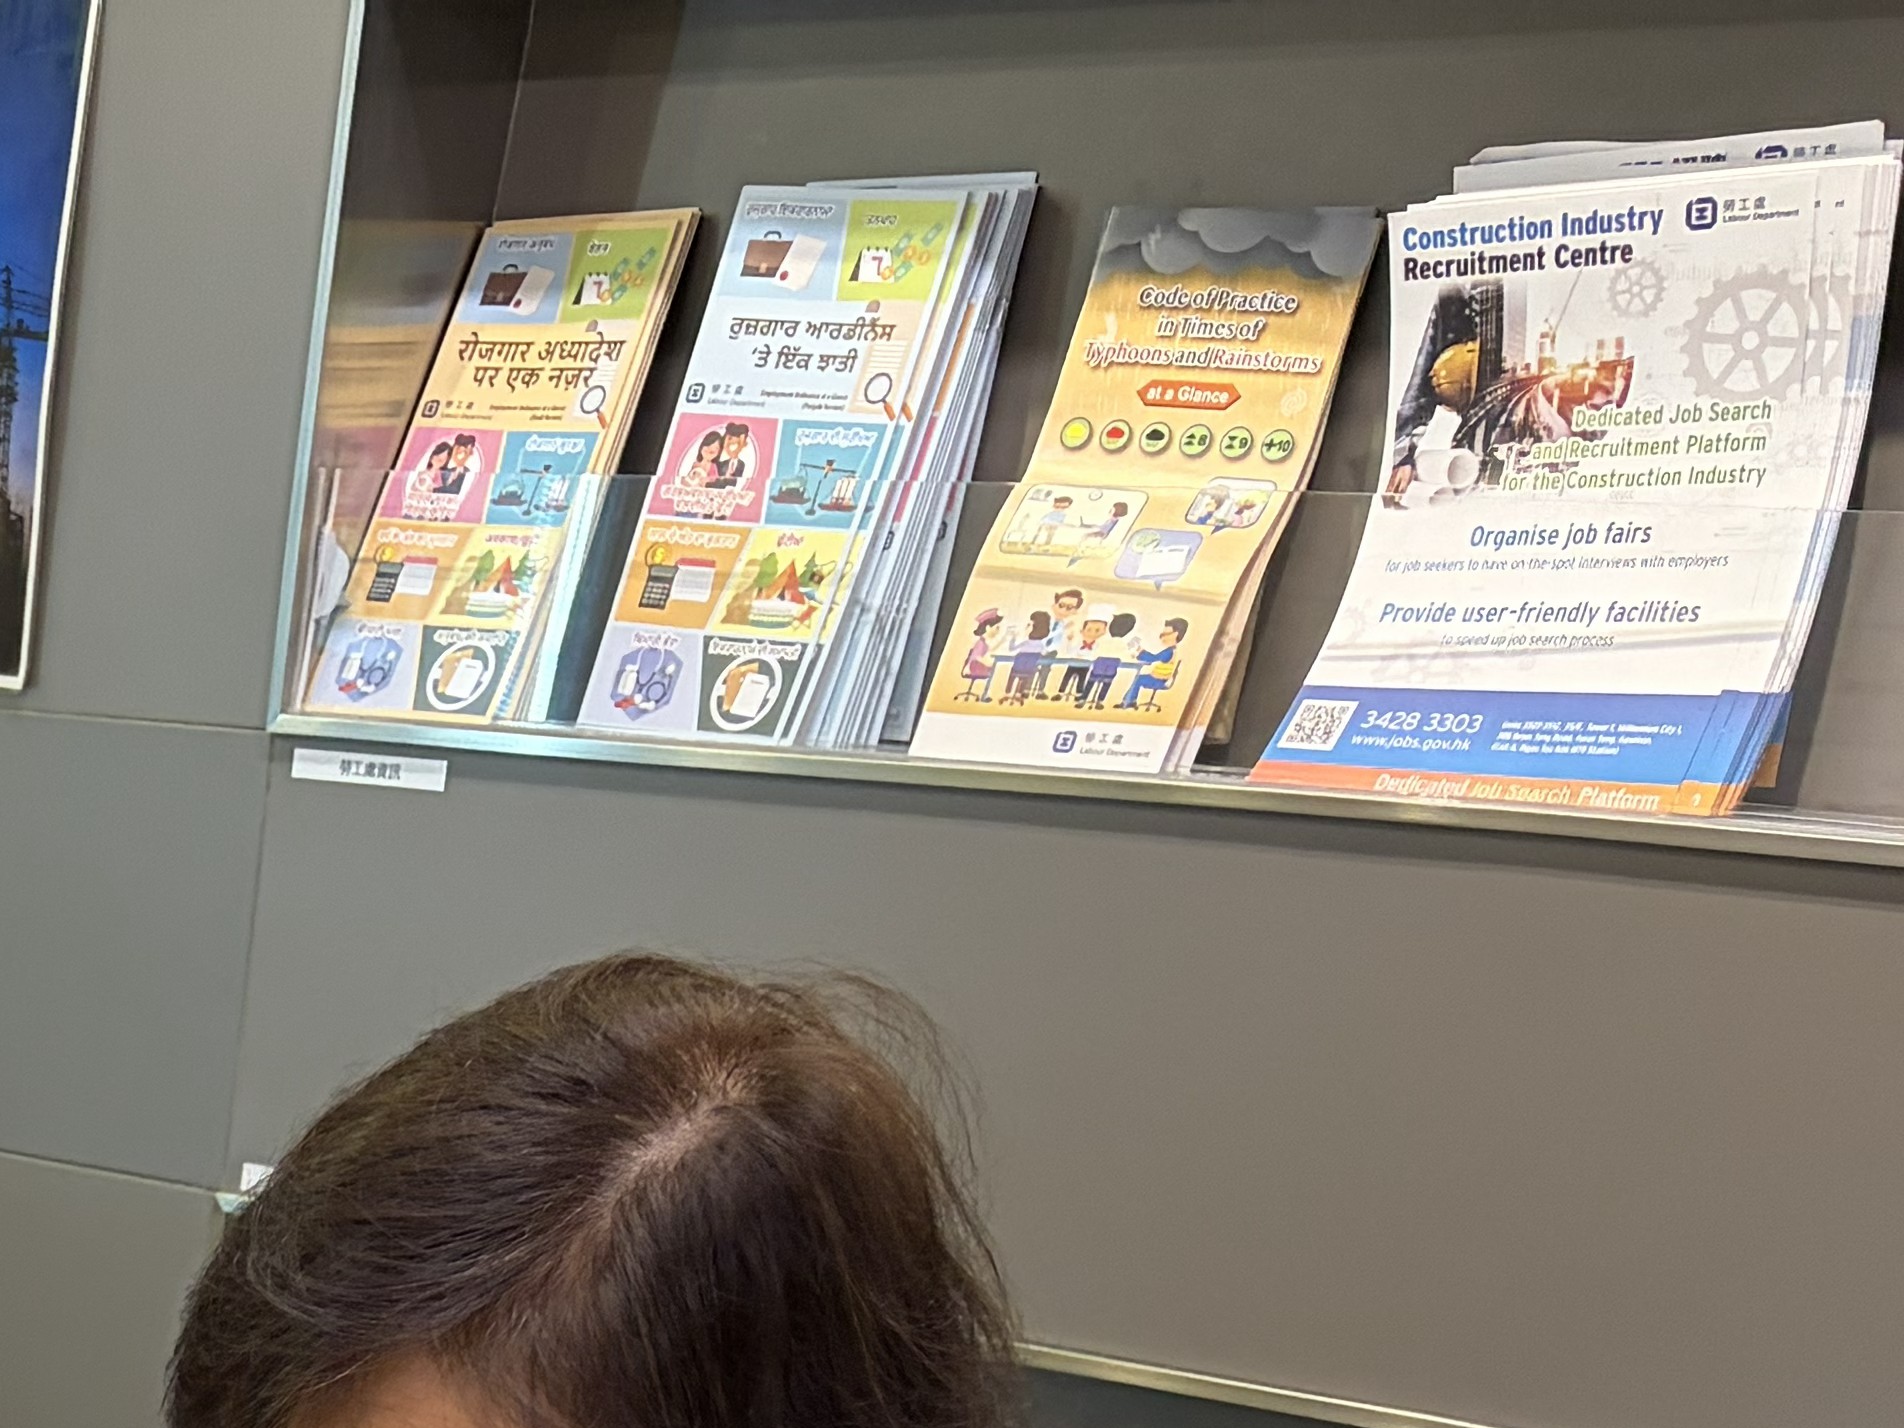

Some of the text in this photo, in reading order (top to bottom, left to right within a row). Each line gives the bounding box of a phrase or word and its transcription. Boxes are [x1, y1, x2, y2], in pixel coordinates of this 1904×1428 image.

[1402, 203, 1664, 252] Construction Industry
[1403, 239, 1634, 282] Recruitment Centre
[1140, 286, 1298, 313] Code of Practice
[1157, 315, 1264, 340] in Times of
[458, 332, 626, 364] रोजगार अध्यादेश
[1085, 341, 1321, 373] Typhoons and Rainstorms
[473, 366, 501, 389] पर
[506, 367, 543, 393] एक
[1146, 387, 1229, 404] at a Glance
[1574, 399, 1772, 430] Dedicated Job Search
[1532, 433, 1767, 461] and Recruitment Platform
[1533, 467, 1562, 490] the
[1567, 464, 1682, 489] Construction
[1689, 466, 1767, 488] Industry
[1470, 521, 1653, 552] Organise job fairs
[1379, 601, 1702, 628] Provide user-friendly facilities
[1360, 710, 1484, 733] 3428 3303
[1351, 734, 1472, 752] www.jobs.gov.hk
[1373, 772, 1468, 799] Dedicated
[1578, 787, 1660, 811] Platform
